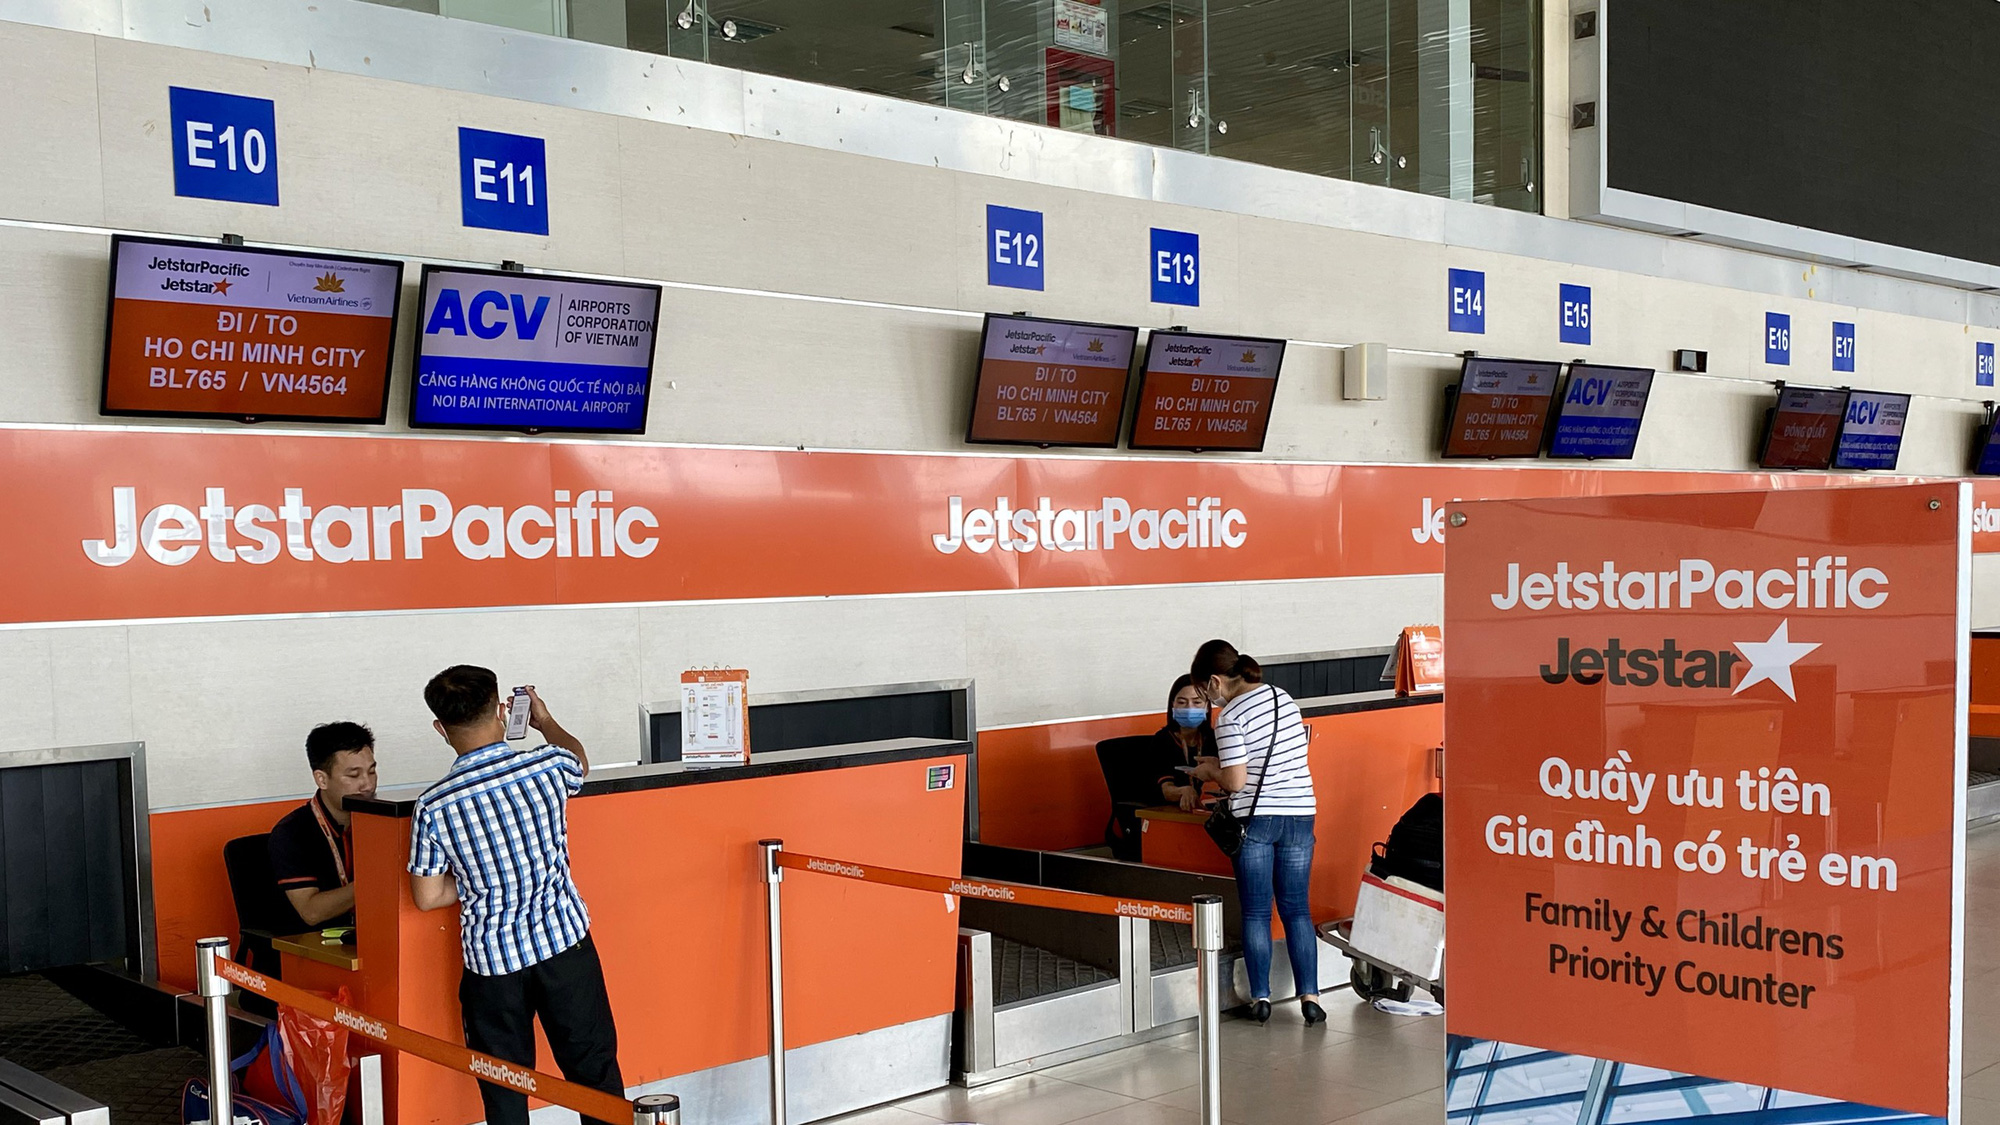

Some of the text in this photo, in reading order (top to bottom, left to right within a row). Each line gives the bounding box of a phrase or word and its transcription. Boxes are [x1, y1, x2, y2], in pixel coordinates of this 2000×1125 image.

[186, 120, 267, 174] E10
[473, 158, 534, 206] E11
[995, 229, 1039, 268] E12
[147, 256, 250, 278] JetstarPacific
[1157, 250, 1195, 286] E13
[161, 277, 214, 294] Jetstar
[568, 299, 631, 316] AIRPORTS
[1454, 287, 1482, 316] E14
[217, 311, 243, 333] ĐI
[264, 314, 298, 336] TO
[425, 288, 551, 341] ACV
[566, 314, 654, 333] CORPORATION
[1564, 301, 1589, 329] E15
[564, 331, 640, 348] OF VIETNAM
[1005, 329, 1057, 343] JetstarPacific
[1769, 327, 1788, 351] E16
[1835, 336, 1853, 359] E17
[144, 337, 366, 368] HO CHI MINH CITY
[1009, 343, 1037, 355] Jetstar
[1164, 343, 1213, 355] JetstarPacific
[1168, 356, 1194, 367] Jetstar
[1035, 366, 1050, 382] ĐI
[1059, 368, 1077, 383] TO
[1978, 354, 1994, 375] E18
[149, 367, 227, 391] BL765
[261, 372, 348, 395] VN4564
[419, 371, 457, 388] CẢNG
[460, 373, 498, 389] HÀNG
[500, 376, 546, 392] KHÔNG
[548, 378, 584, 396] QUỐC
[586, 378, 601, 394] TẾ
[602, 381, 624, 398] NỘI
[1190, 378, 1206, 393] ĐI
[1213, 379, 1231, 394] TO
[1566, 377, 1613, 406] ACV
[432, 394, 631, 414] NOI BAI INTERNATIONAL AIRPORT
[996, 385, 1110, 406] HO CHI MINH CITY
[1154, 396, 1260, 414] HO CHI MINH CITY
[997, 405, 1037, 423] BL765
[1053, 409, 1099, 426] VN4564
[1154, 416, 1191, 432] BL765
[1206, 418, 1248, 433] VN4564
[1465, 412, 1480, 424] HO
[1519, 414, 1539, 426] CITY
[1845, 400, 1880, 425] ACV
[82, 486, 660, 566] JetstarPacific
[932, 495, 1248, 555] JetstarPacific
[1412, 497, 1446, 545] Je
[1491, 556, 1890, 611] JetstarPacific
[1540, 637, 1741, 689] Jetstar
[1539, 750, 1832, 817] Quầy ưu tiên
[806, 856, 865, 878] JetstarPacific
[1485, 816, 1898, 893] Gia đình có trẻ em
[948, 879, 1015, 901] JetstarPacific
[1114, 900, 1193, 923] JetstarPacific
[1525, 893, 1845, 961] Family & Childrens
[222, 961, 267, 993] JetstarPacific
[1549, 944, 1816, 1010] Priority Counter
[332, 1006, 388, 1041] JetstarPacific
[468, 1054, 537, 1093] JetstarPacific
